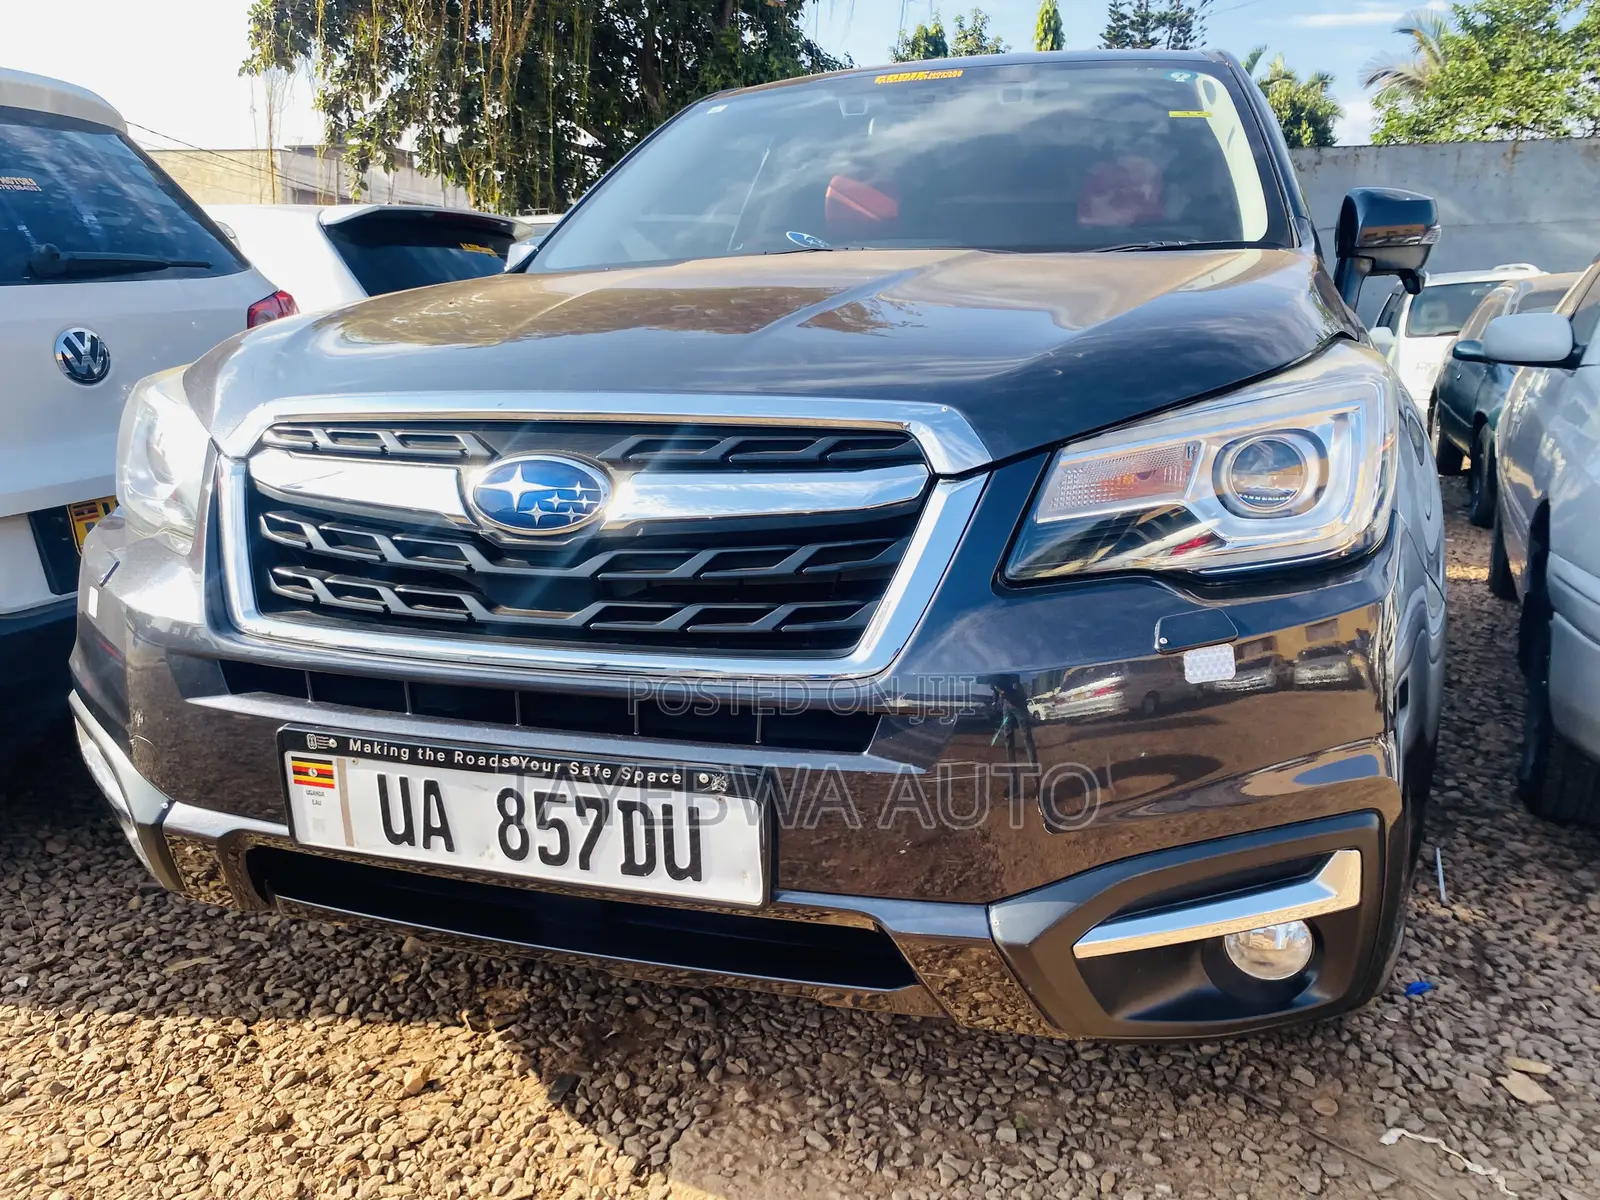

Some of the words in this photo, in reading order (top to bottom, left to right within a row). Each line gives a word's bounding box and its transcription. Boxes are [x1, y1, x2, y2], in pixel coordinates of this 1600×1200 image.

[54, 327, 110, 386] VW
[349, 739, 410, 760] Making
[418, 747, 446, 762] the
[454, 750, 510, 768] Roads
[518, 756, 561, 773] Your
[569, 761, 612, 779] Safe
[621, 767, 682, 784] Space
[376, 773, 456, 852] UA
[496, 786, 703, 882] 857DU
